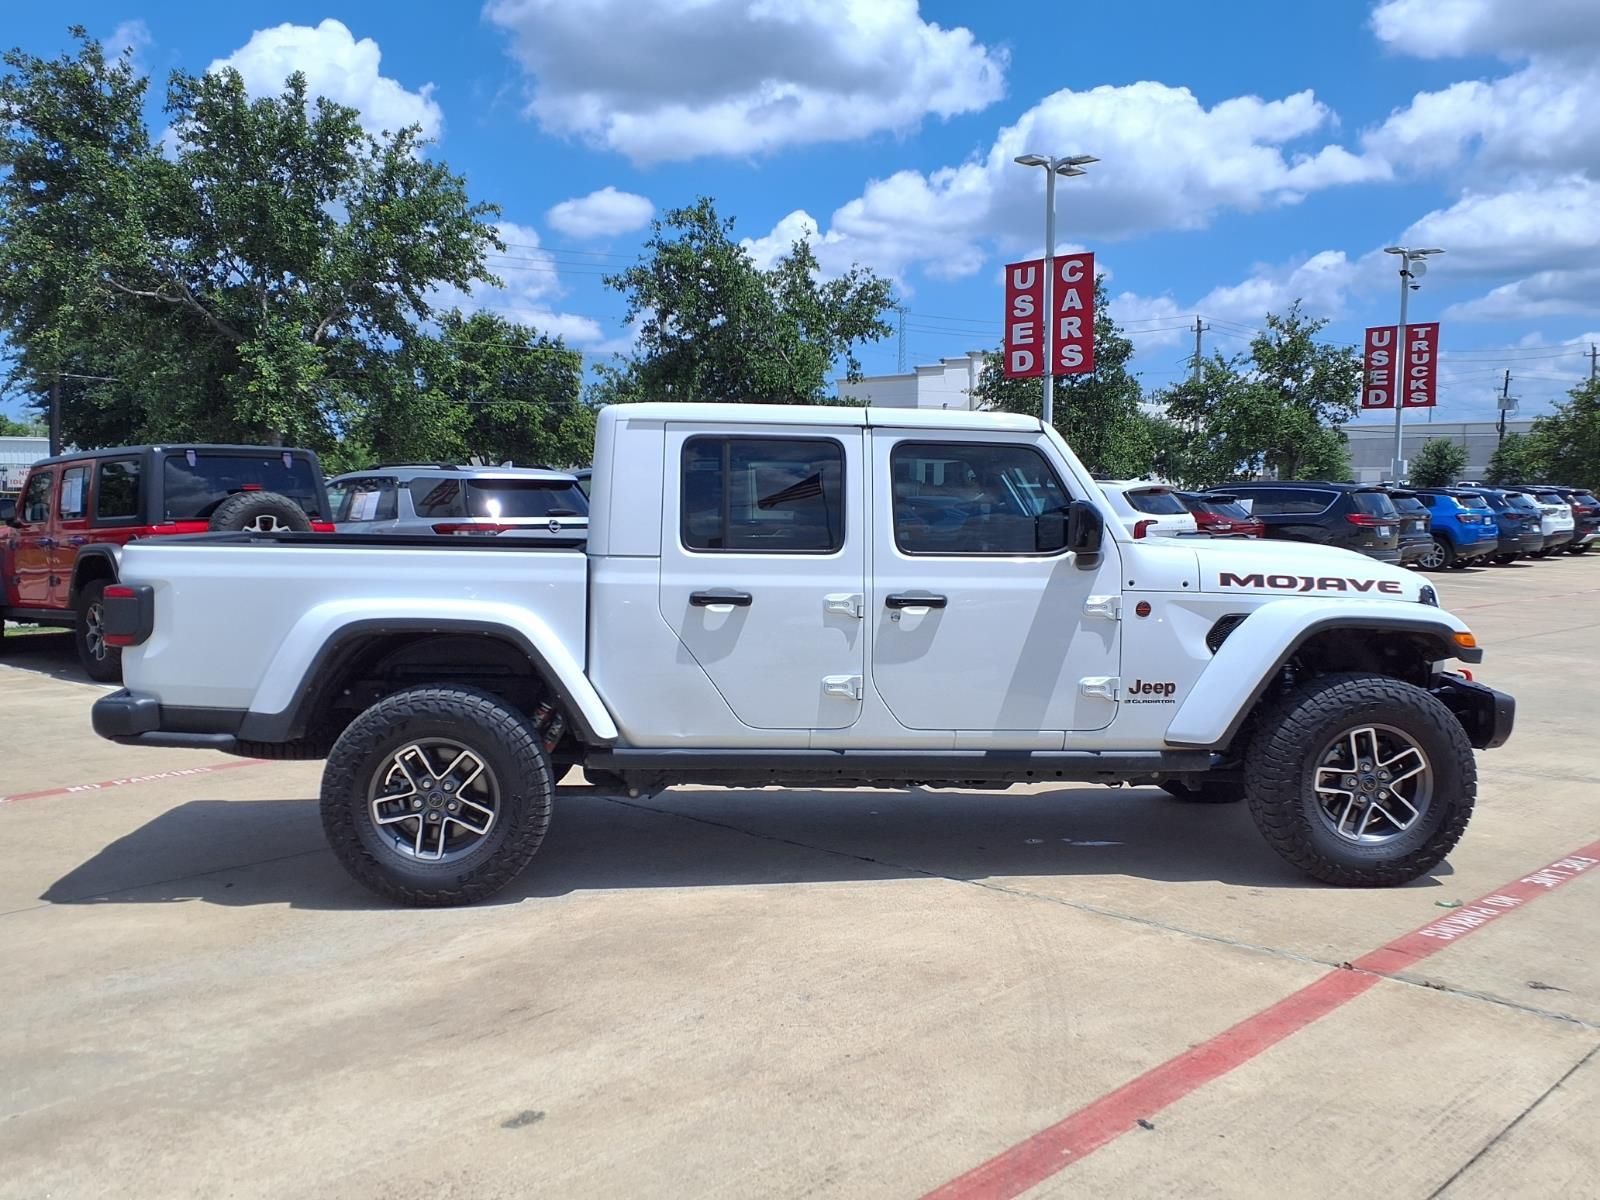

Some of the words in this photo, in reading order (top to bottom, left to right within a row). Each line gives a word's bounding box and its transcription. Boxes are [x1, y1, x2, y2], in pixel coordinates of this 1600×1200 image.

[1011, 266, 1036, 373] USED
[1060, 260, 1084, 367] CARS
[1368, 330, 1391, 405] USED
[1409, 327, 1432, 403] TRUCKS
[1219, 572, 1403, 594] MOJAVE
[1128, 679, 1176, 697] Jeep
[66, 783, 101, 793] NO
[110, 767, 213, 786] PARKING
[1481, 894, 1525, 908] NO
[1418, 905, 1500, 940] PARKING
